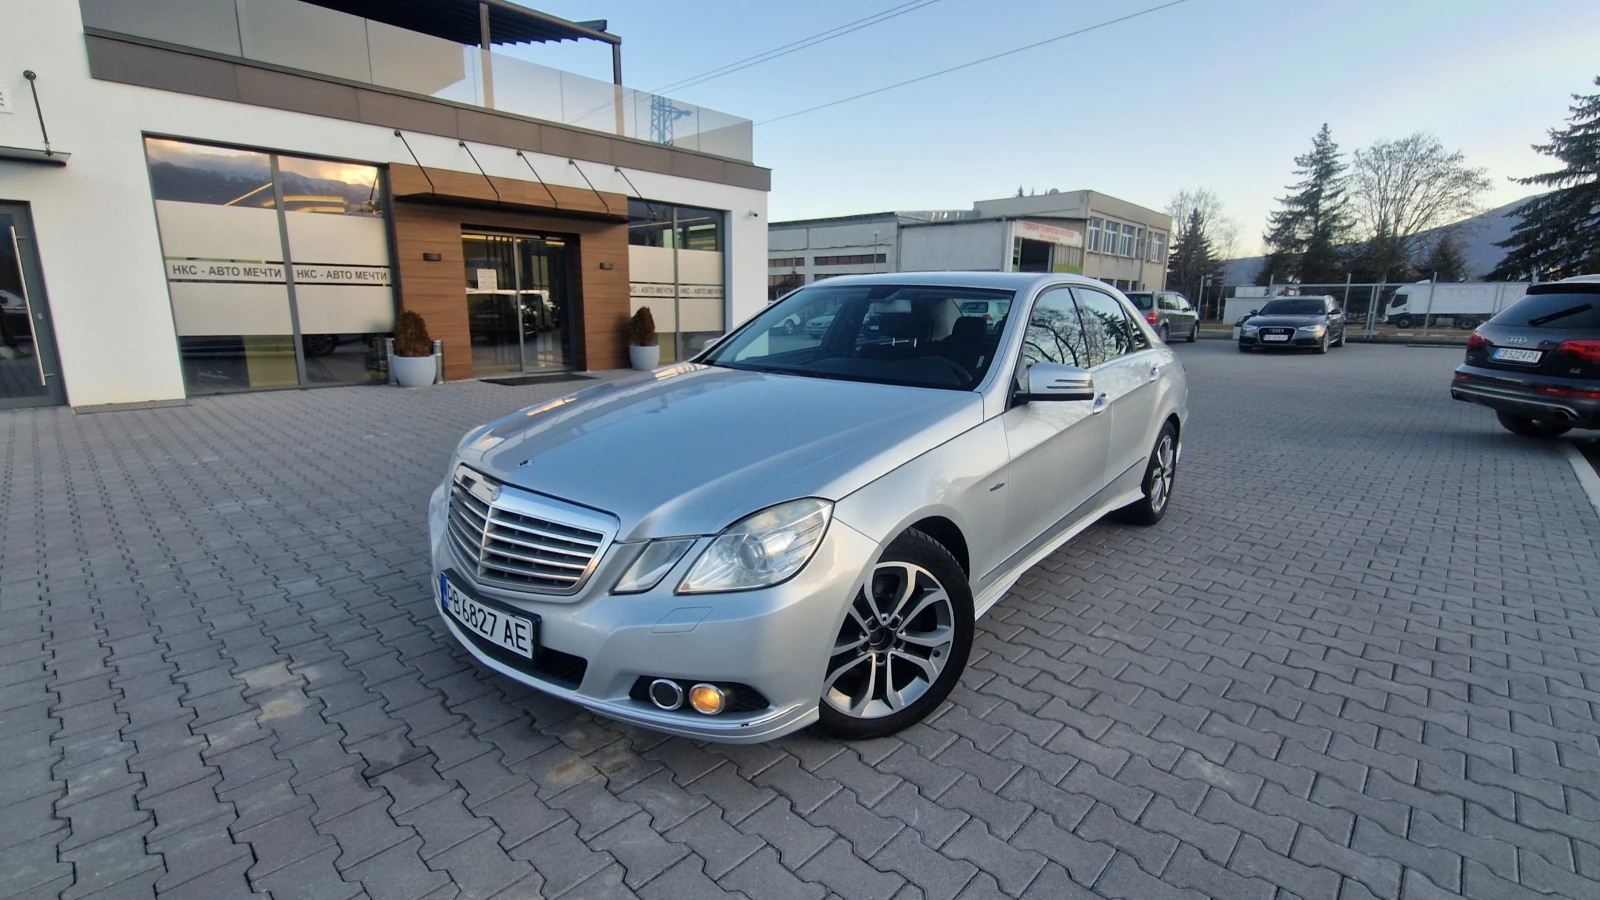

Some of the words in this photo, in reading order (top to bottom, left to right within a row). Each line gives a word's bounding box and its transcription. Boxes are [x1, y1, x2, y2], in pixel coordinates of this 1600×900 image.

[172, 265, 197, 275] НКС
[208, 266, 240, 276] АВТО
[243, 267, 282, 277] МЕЧТИ
[296, 269, 317, 278] НКС
[326, 270, 352, 279] АВТО
[355, 271, 387, 280] МЕЧТИ
[463, 599, 497, 637] 6827
[504, 619, 528, 652] AE
